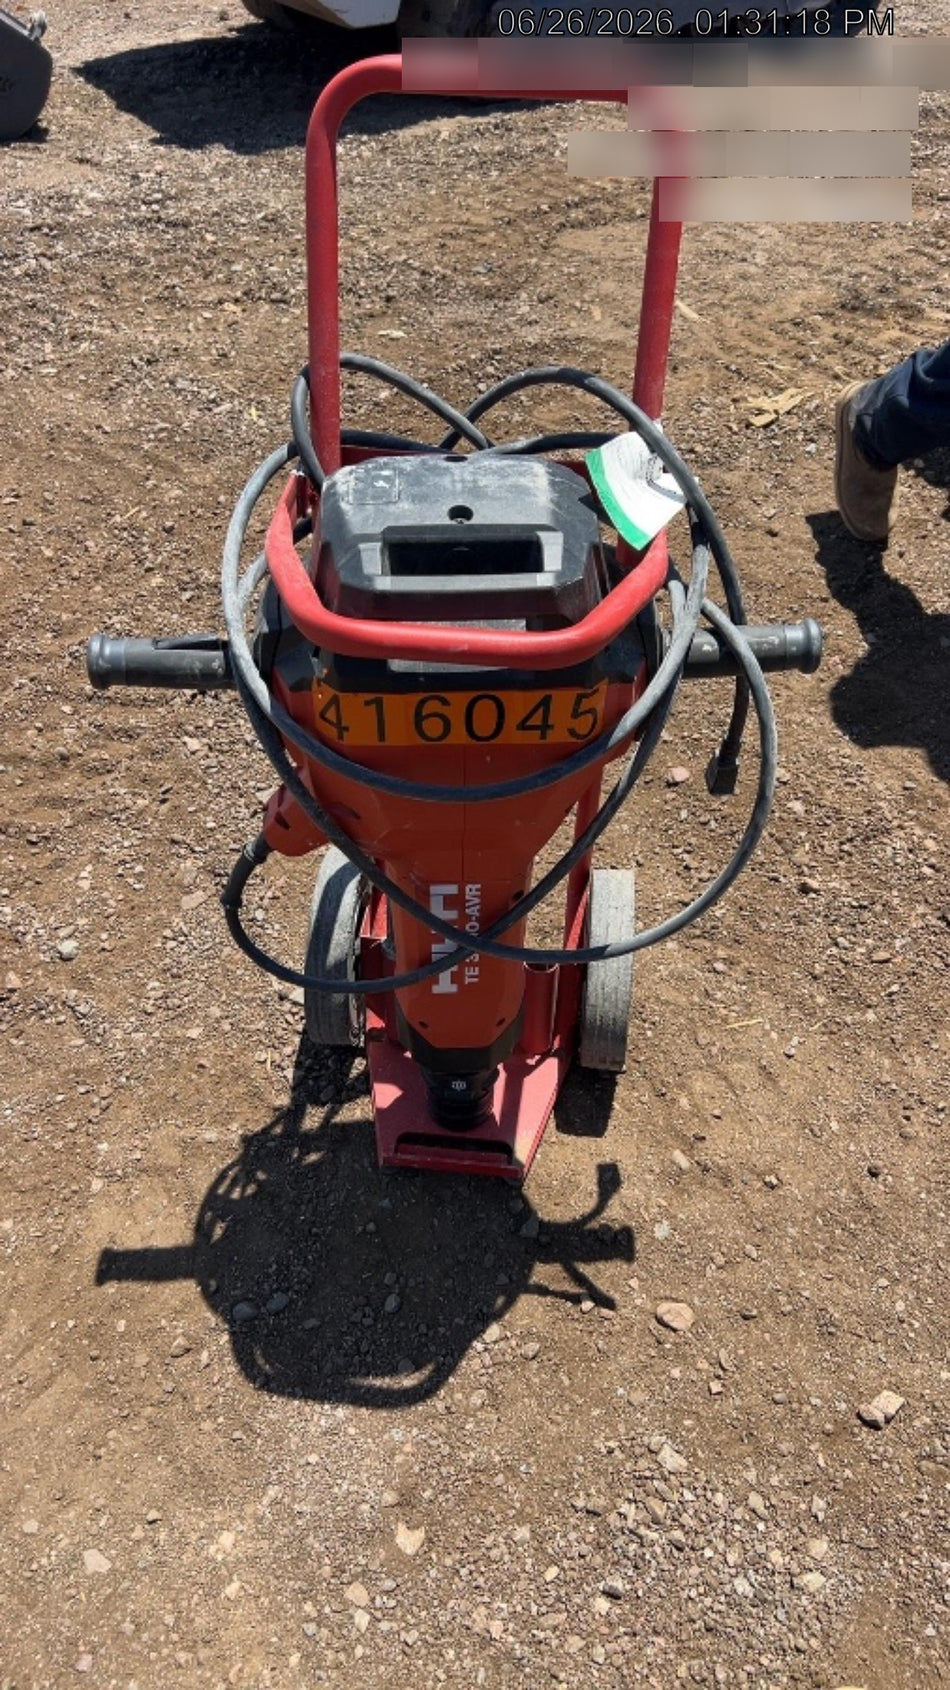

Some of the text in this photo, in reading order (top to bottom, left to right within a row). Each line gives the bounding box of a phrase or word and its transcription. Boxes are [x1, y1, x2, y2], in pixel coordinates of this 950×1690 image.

[318, 688, 600, 742] 416045
[464, 883, 482, 985] TE 30-AVR
